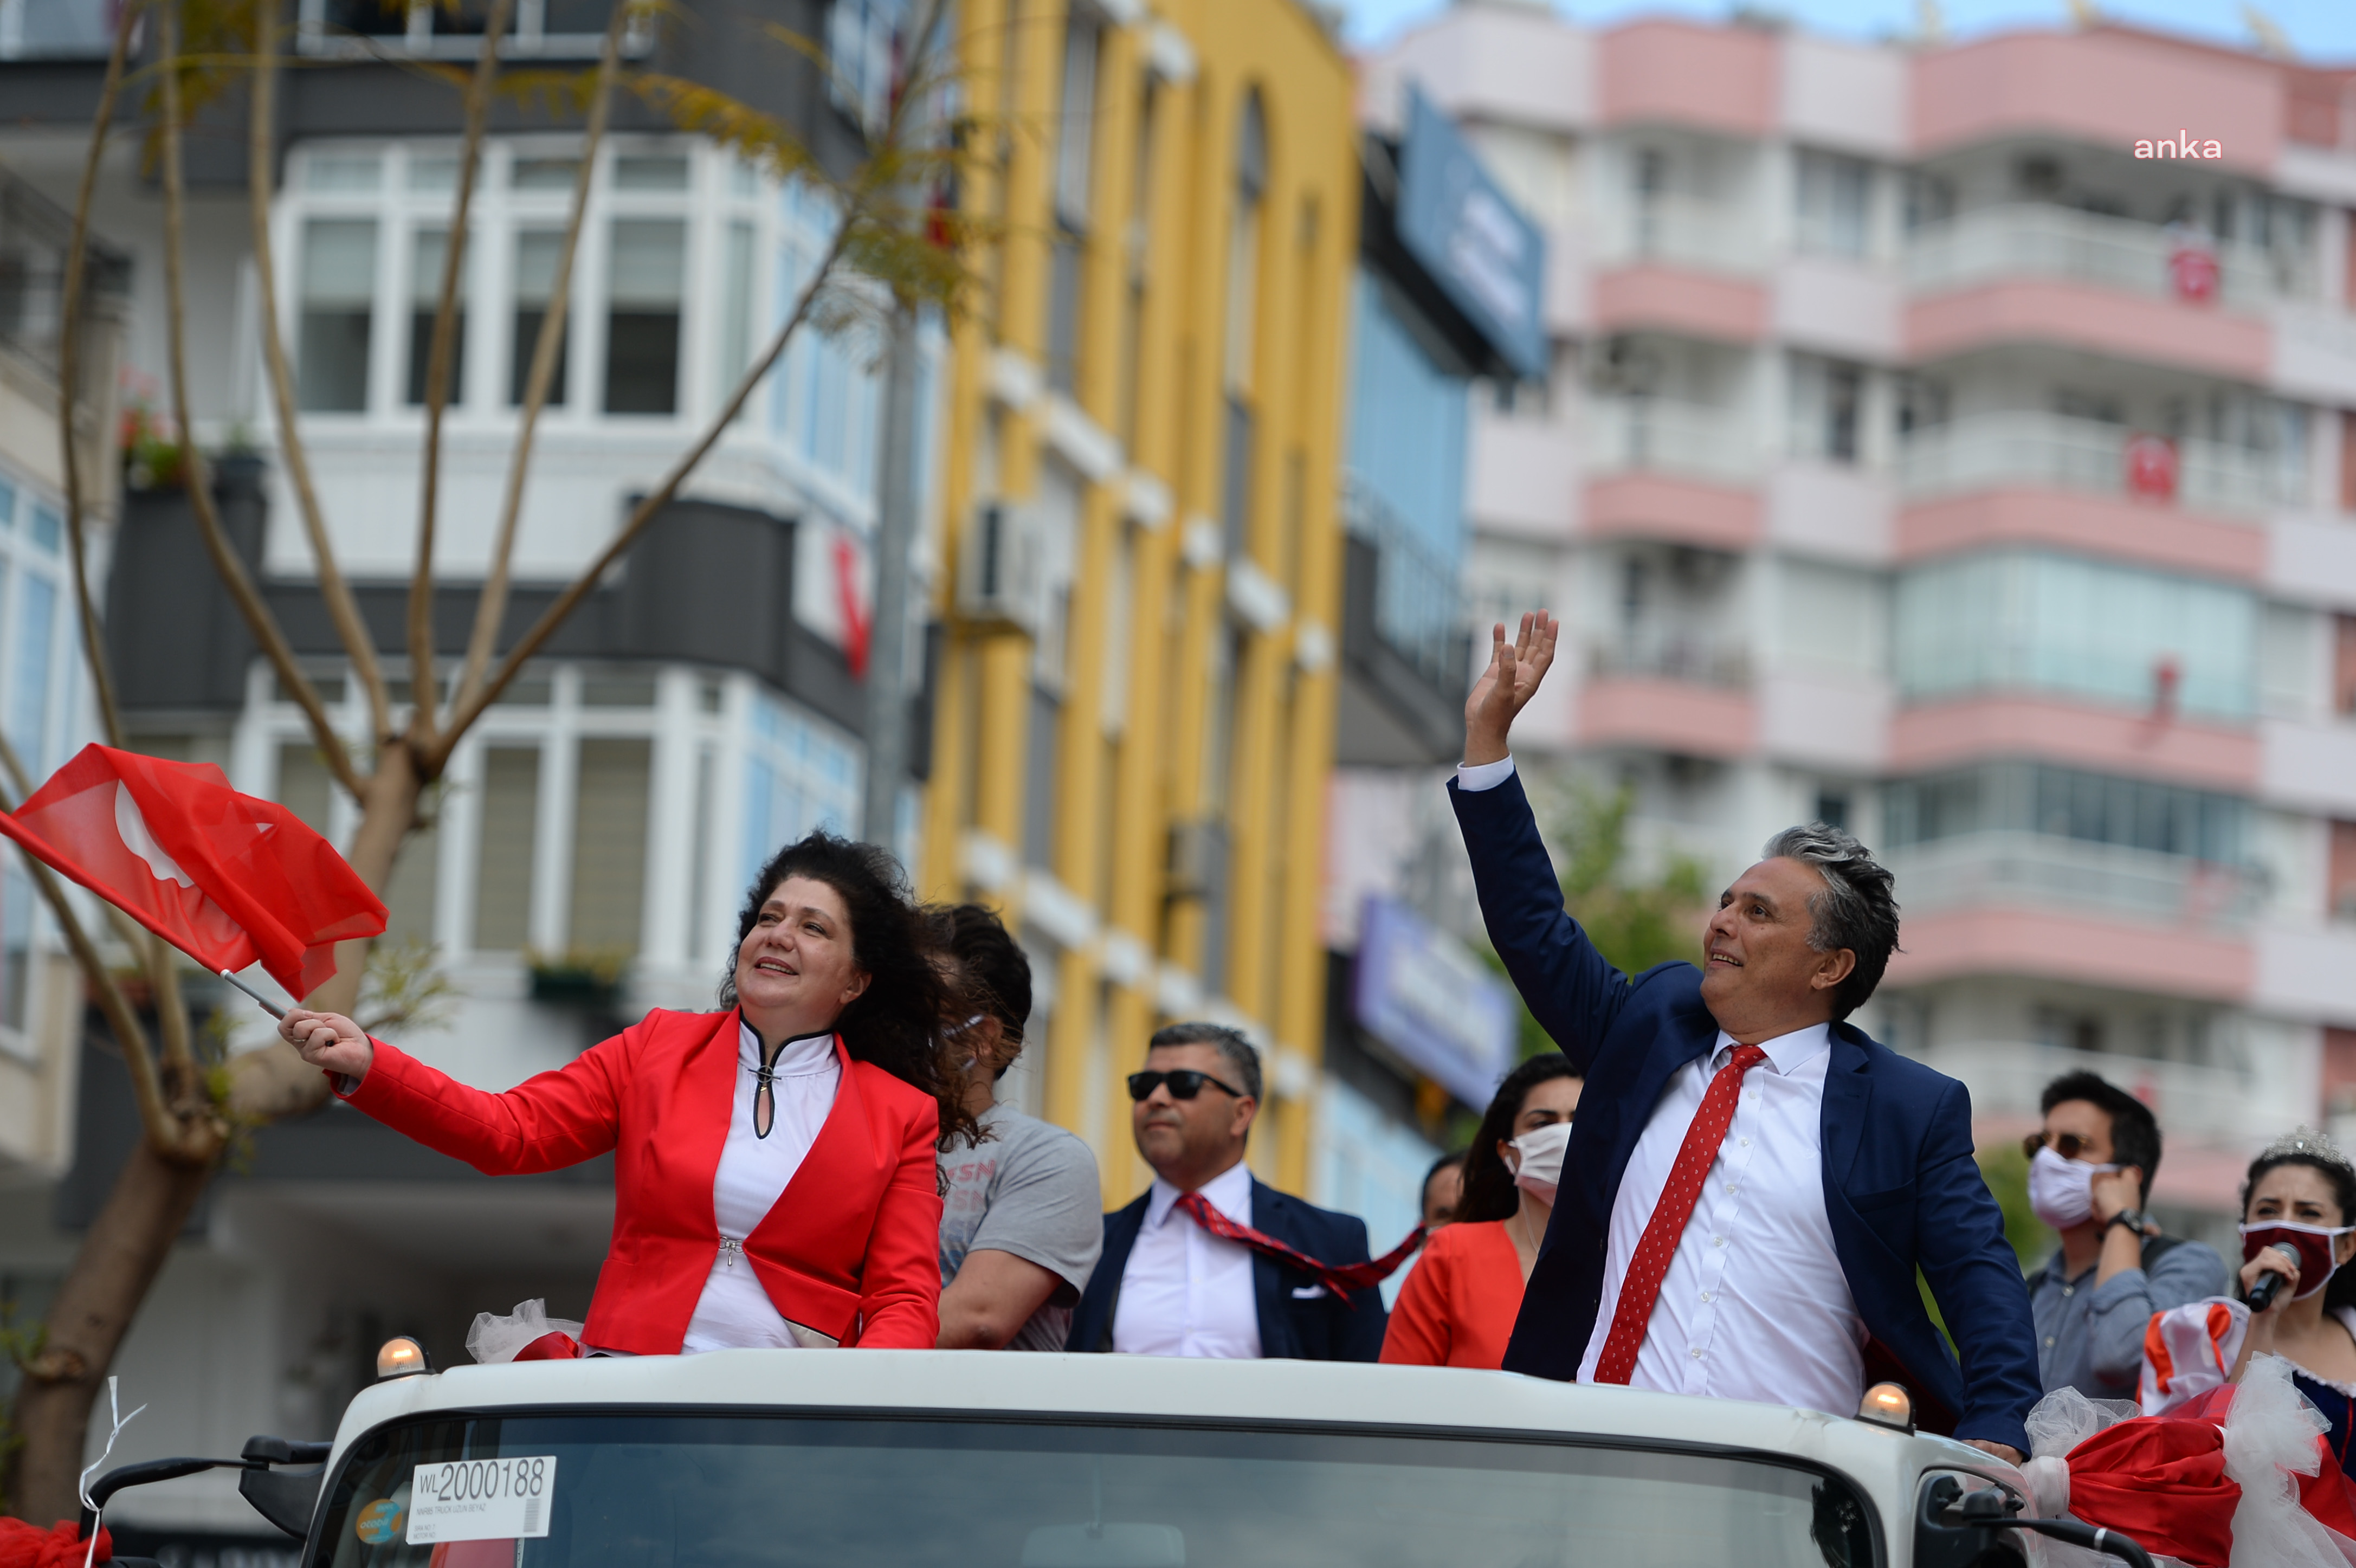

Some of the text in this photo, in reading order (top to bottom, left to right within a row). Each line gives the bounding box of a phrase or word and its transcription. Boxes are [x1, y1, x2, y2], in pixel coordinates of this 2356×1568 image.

[435, 1505, 451, 1514] TRUCK
[453, 1505, 467, 1513] UZUN
[468, 1503, 486, 1512] BEYAZ
